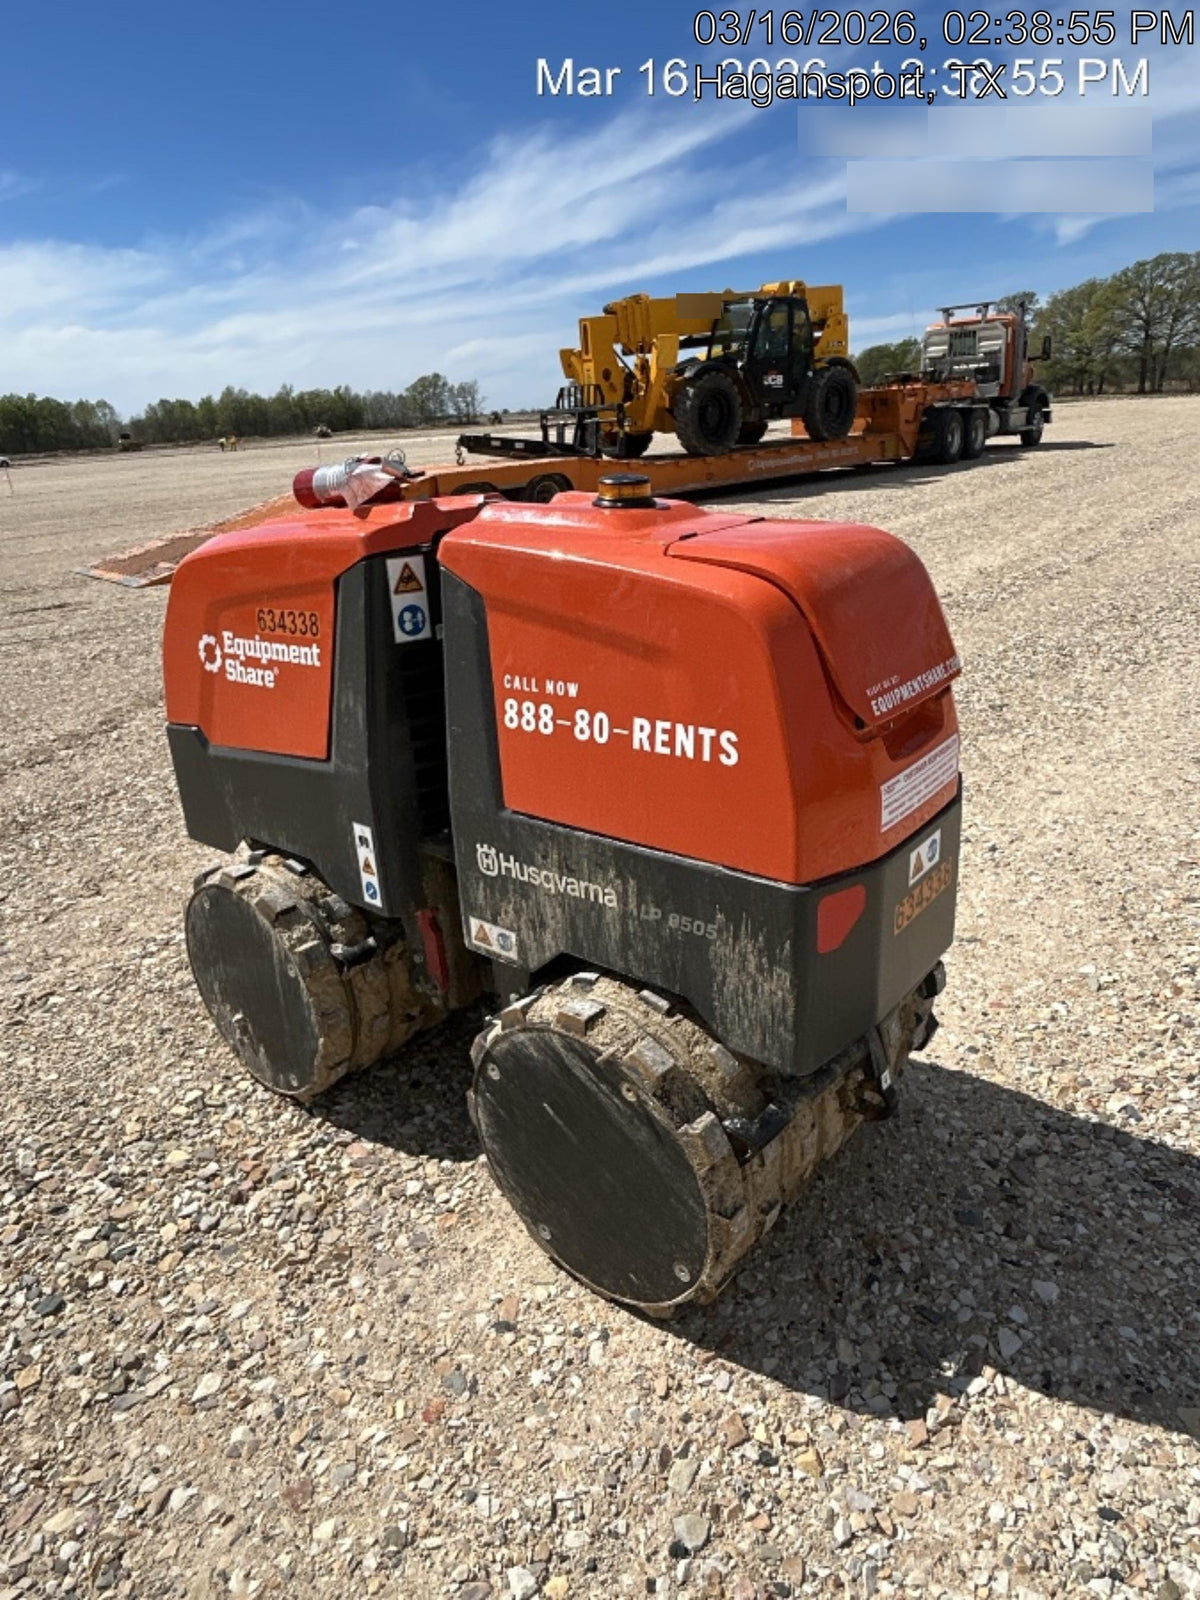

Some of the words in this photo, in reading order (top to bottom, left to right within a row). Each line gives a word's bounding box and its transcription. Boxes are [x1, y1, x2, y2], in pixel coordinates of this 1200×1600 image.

[257, 609, 319, 637] 634338
[222, 630, 321, 667] Equipment
[225, 658, 275, 689] Share
[503, 673, 539, 693] CALL
[545, 678, 579, 698] NOW
[503, 697, 740, 767] 888-80-RENTS
[499, 852, 617, 908] Husqvarna
